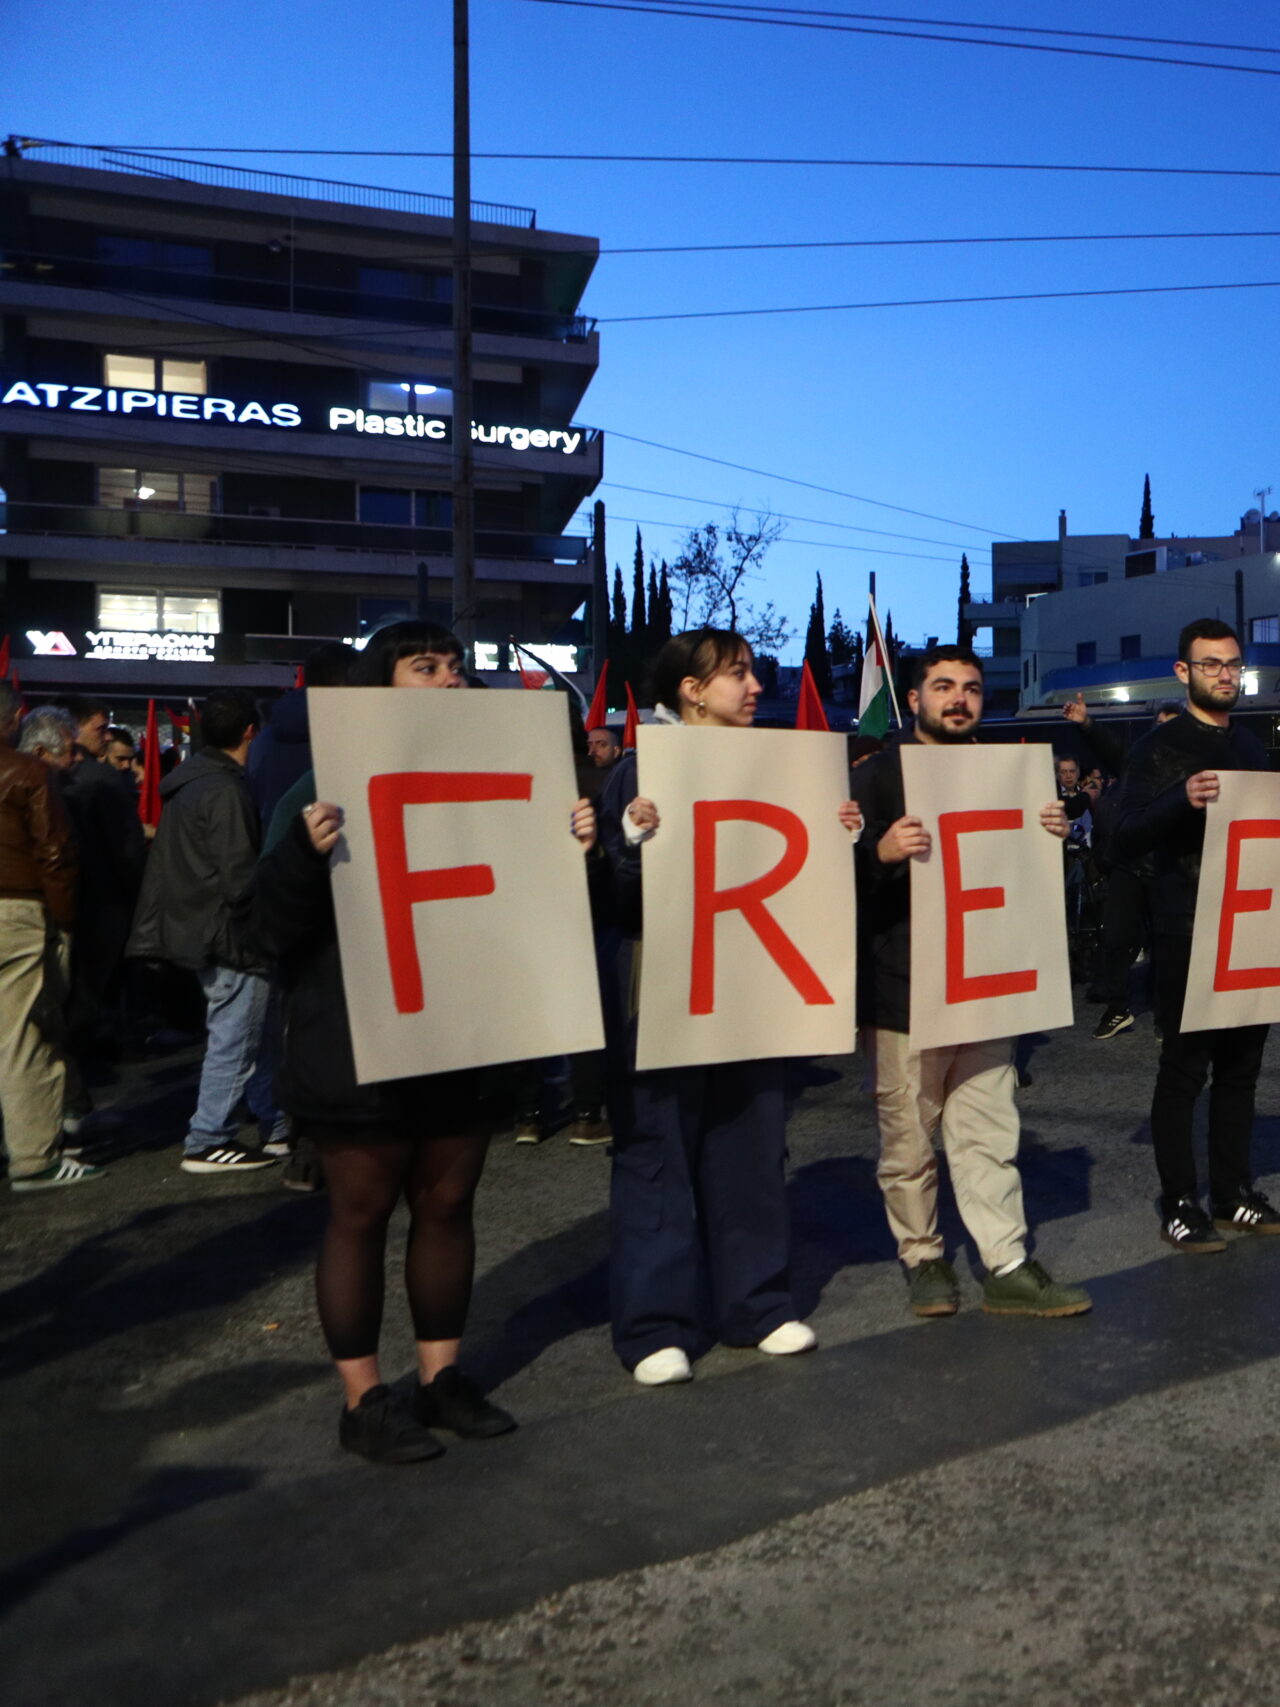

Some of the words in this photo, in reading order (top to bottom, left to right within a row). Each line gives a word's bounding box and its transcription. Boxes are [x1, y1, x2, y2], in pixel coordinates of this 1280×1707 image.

[2, 381, 302, 427] ATZIPIERAS
[329, 407, 447, 439] Plastic
[471, 420, 581, 455] urgery
